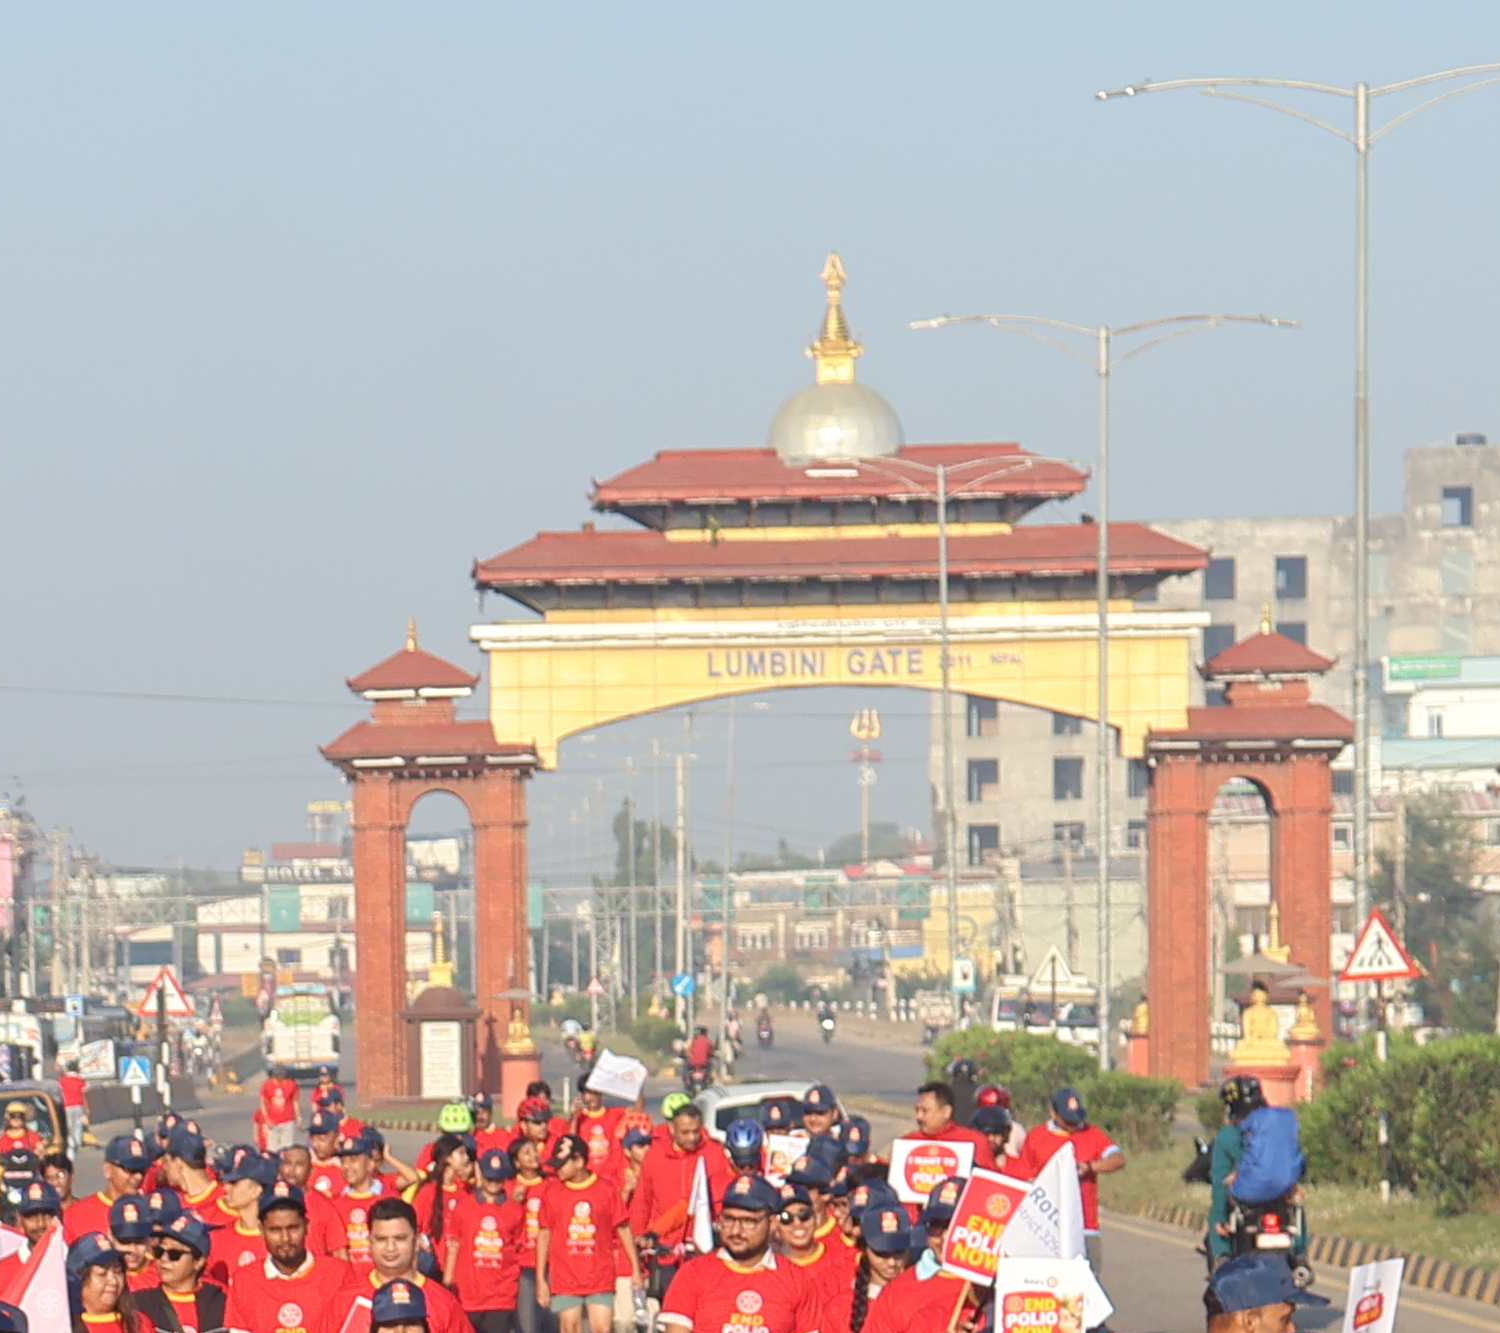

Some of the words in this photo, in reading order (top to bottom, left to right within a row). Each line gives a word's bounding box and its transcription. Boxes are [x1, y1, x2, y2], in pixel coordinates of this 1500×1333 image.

[708, 650, 826, 677] LUMBINI
[848, 650, 923, 675] GATE
[1025, 1297, 1056, 1312] END
[1006, 1311, 1058, 1328] POLIO
